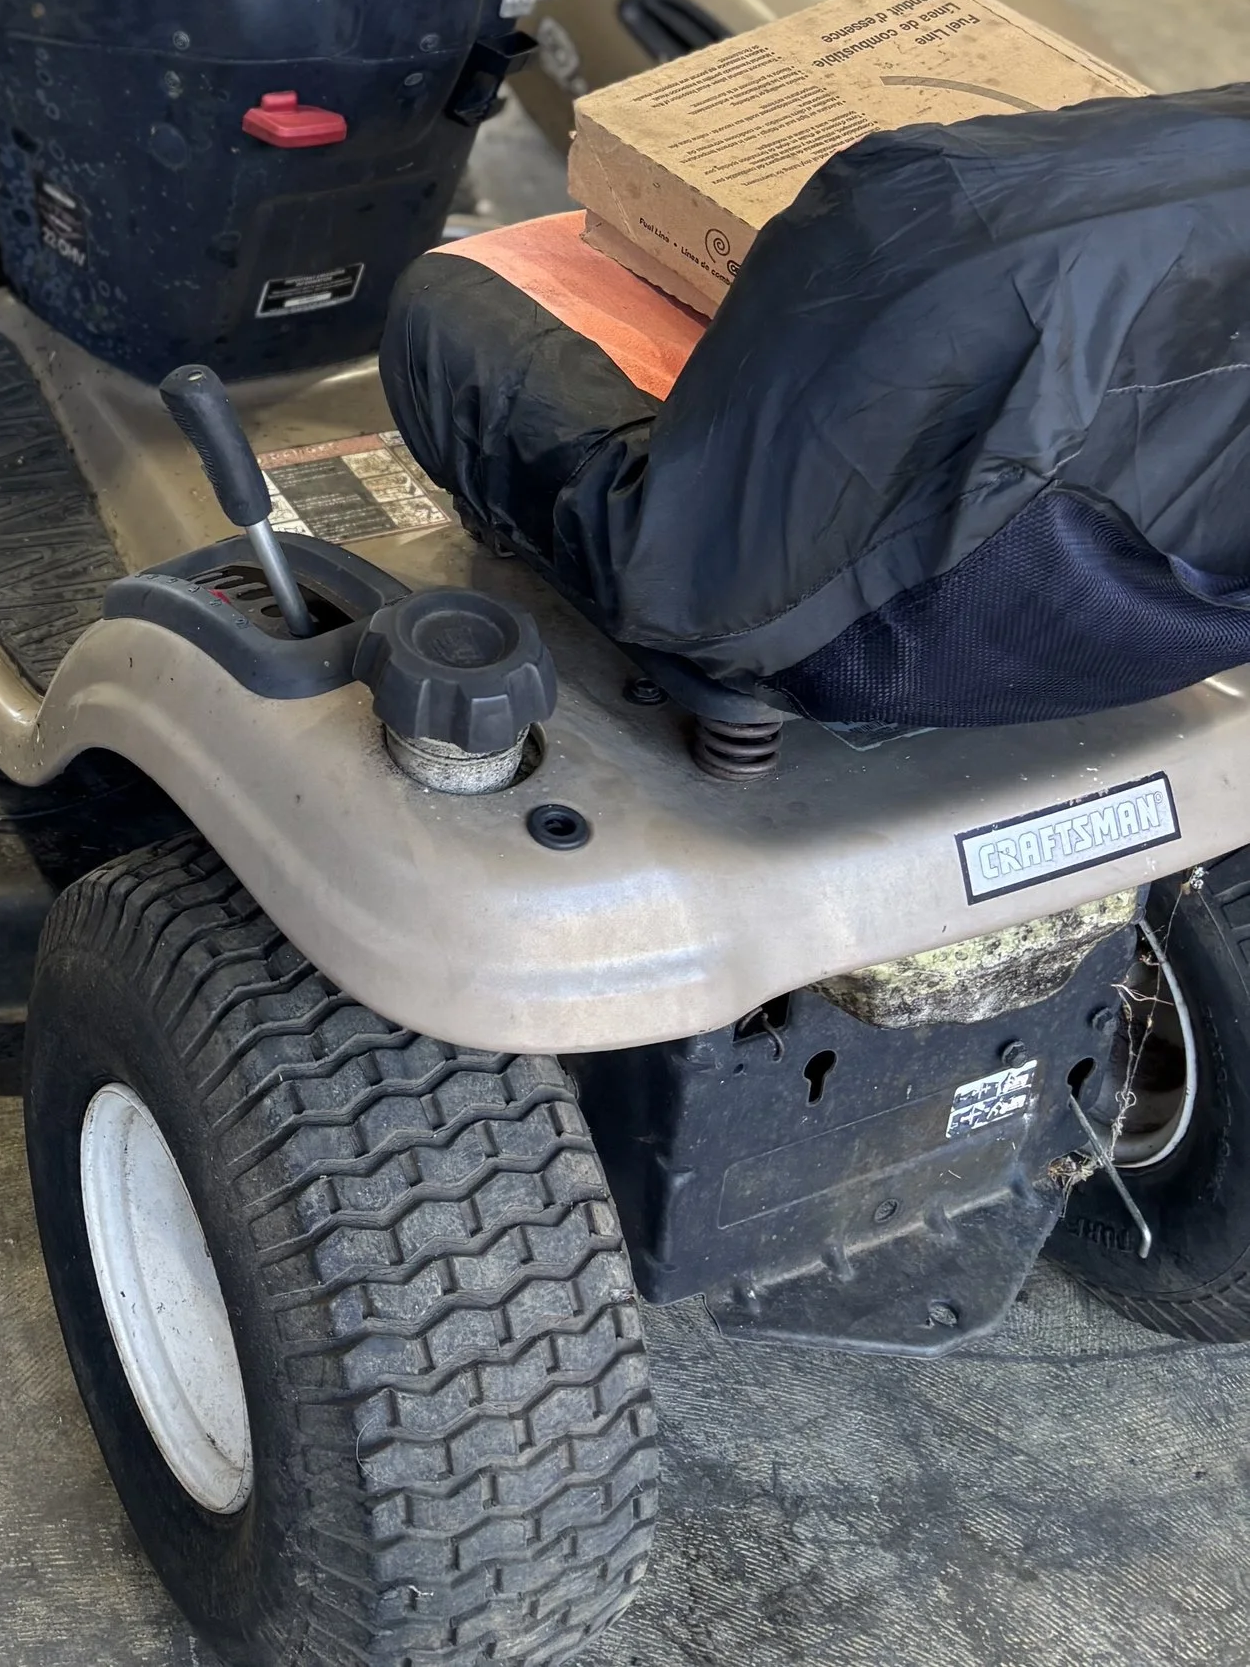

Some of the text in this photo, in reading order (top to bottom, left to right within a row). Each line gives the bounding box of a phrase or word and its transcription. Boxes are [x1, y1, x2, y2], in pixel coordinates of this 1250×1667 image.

[821, 11, 888, 43] d'essence
[899, 18, 920, 31] de
[915, 14, 981, 45] Fuel Line
[812, 29, 899, 68] combustible
[639, 217, 654, 234] Fuel
[655, 228, 670, 243] Line
[701, 261, 710, 271] de
[978, 792, 1161, 880] CRAFTSMAN
